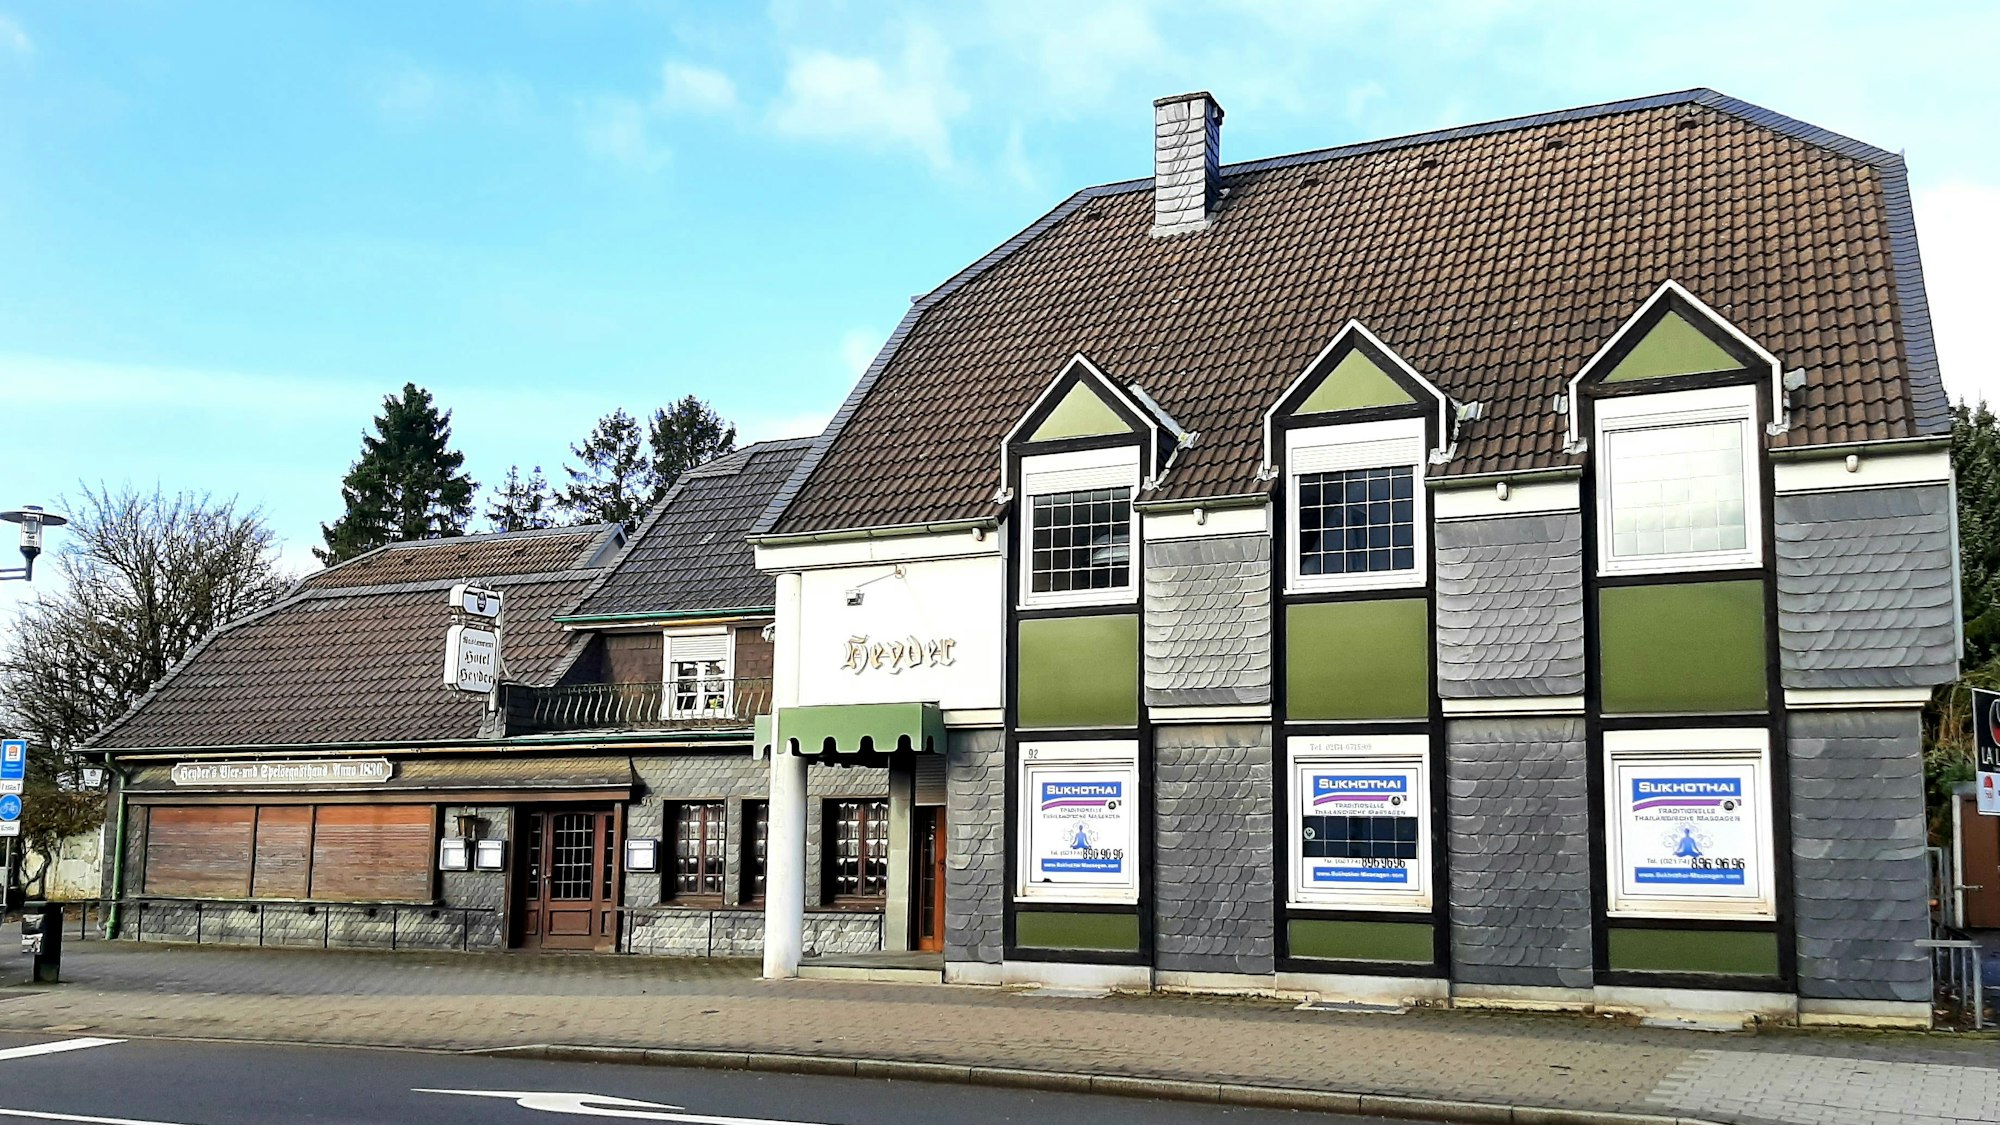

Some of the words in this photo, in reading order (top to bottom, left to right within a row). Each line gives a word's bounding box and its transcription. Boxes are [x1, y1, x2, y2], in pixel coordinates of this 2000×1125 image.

[464, 650, 490, 666] Hotel
[840, 634, 957, 675] Heyder
[460, 668, 493, 685] Heyder
[1028, 748, 1039, 759] 92
[1981, 745, 1994, 765] LA
[332, 762, 356, 777] Anno
[1318, 778, 1401, 789] SUKHOTHAI
[1638, 781, 1735, 793] SUKHOTHAI
